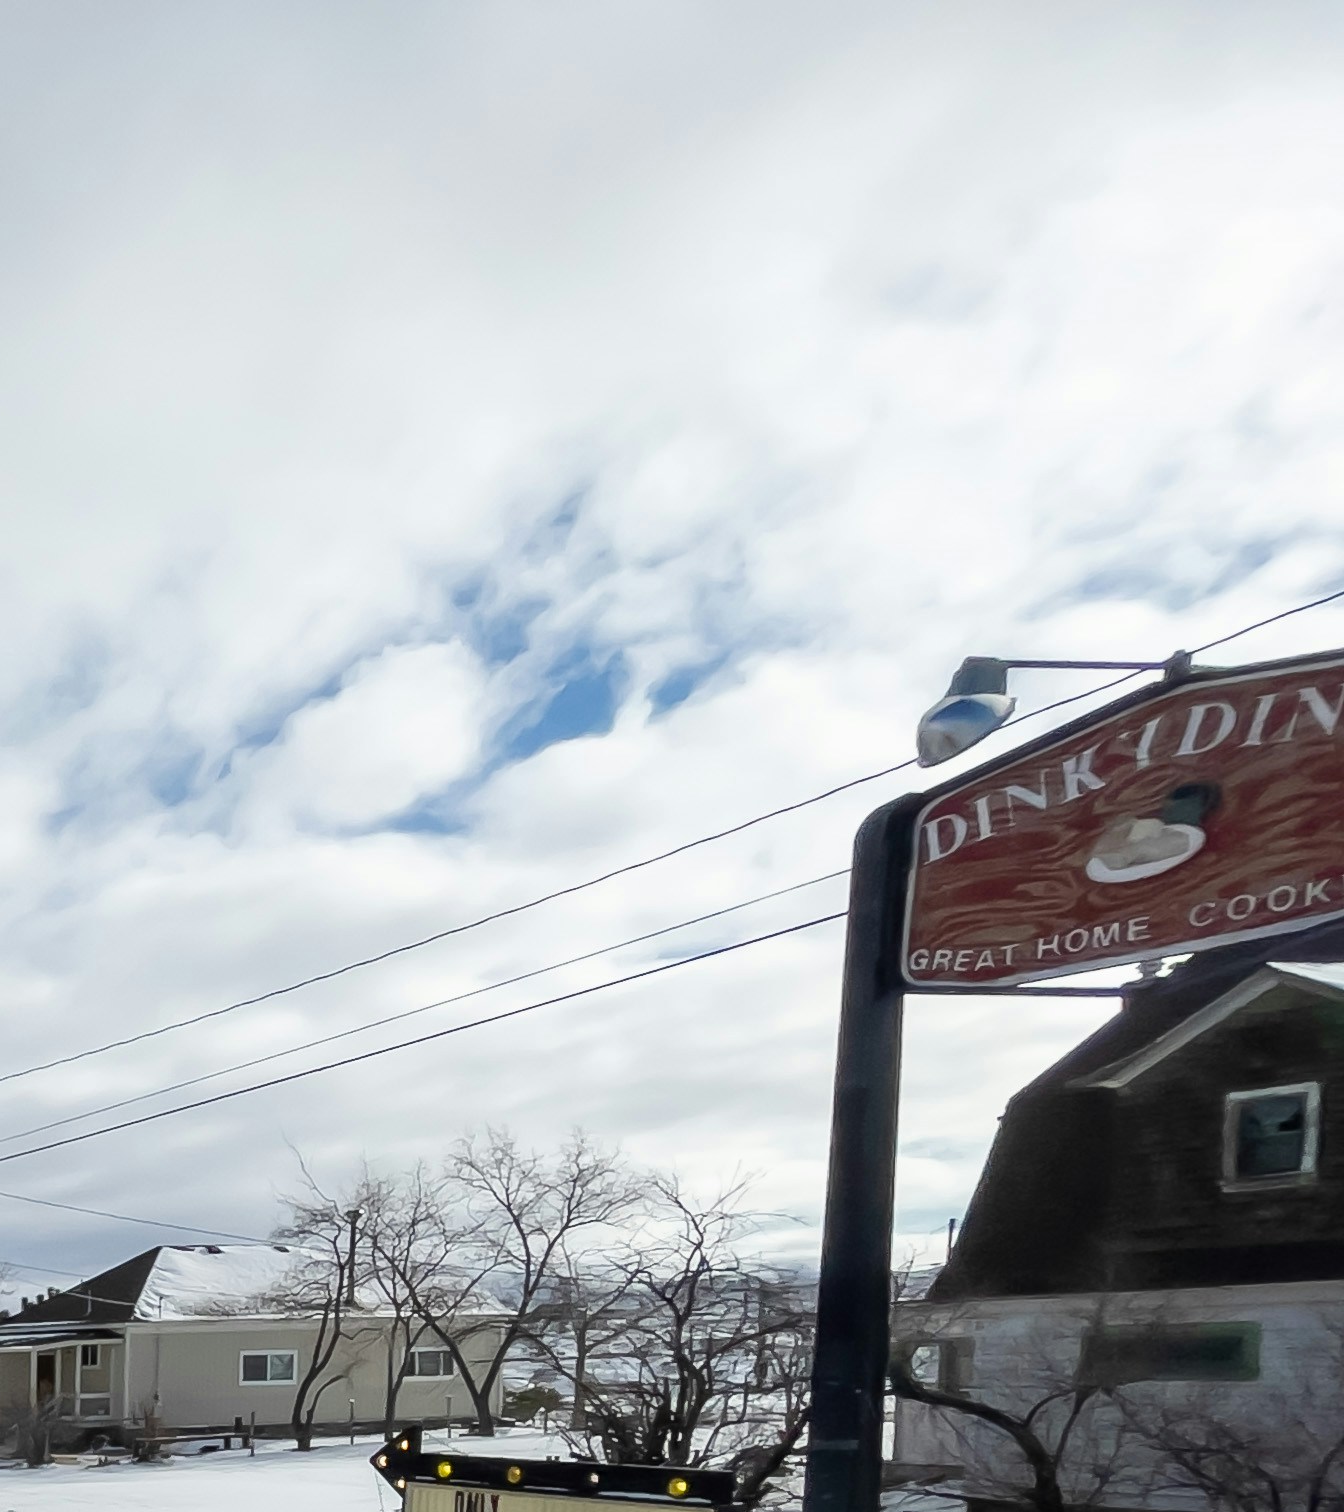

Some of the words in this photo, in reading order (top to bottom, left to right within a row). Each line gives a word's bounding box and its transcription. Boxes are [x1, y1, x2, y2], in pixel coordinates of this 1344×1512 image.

[921, 716, 1161, 866] DINKY
[909, 943, 1020, 973] GREAT
[1037, 915, 1152, 960] HOME
[1189, 875, 1344, 928] COOK
